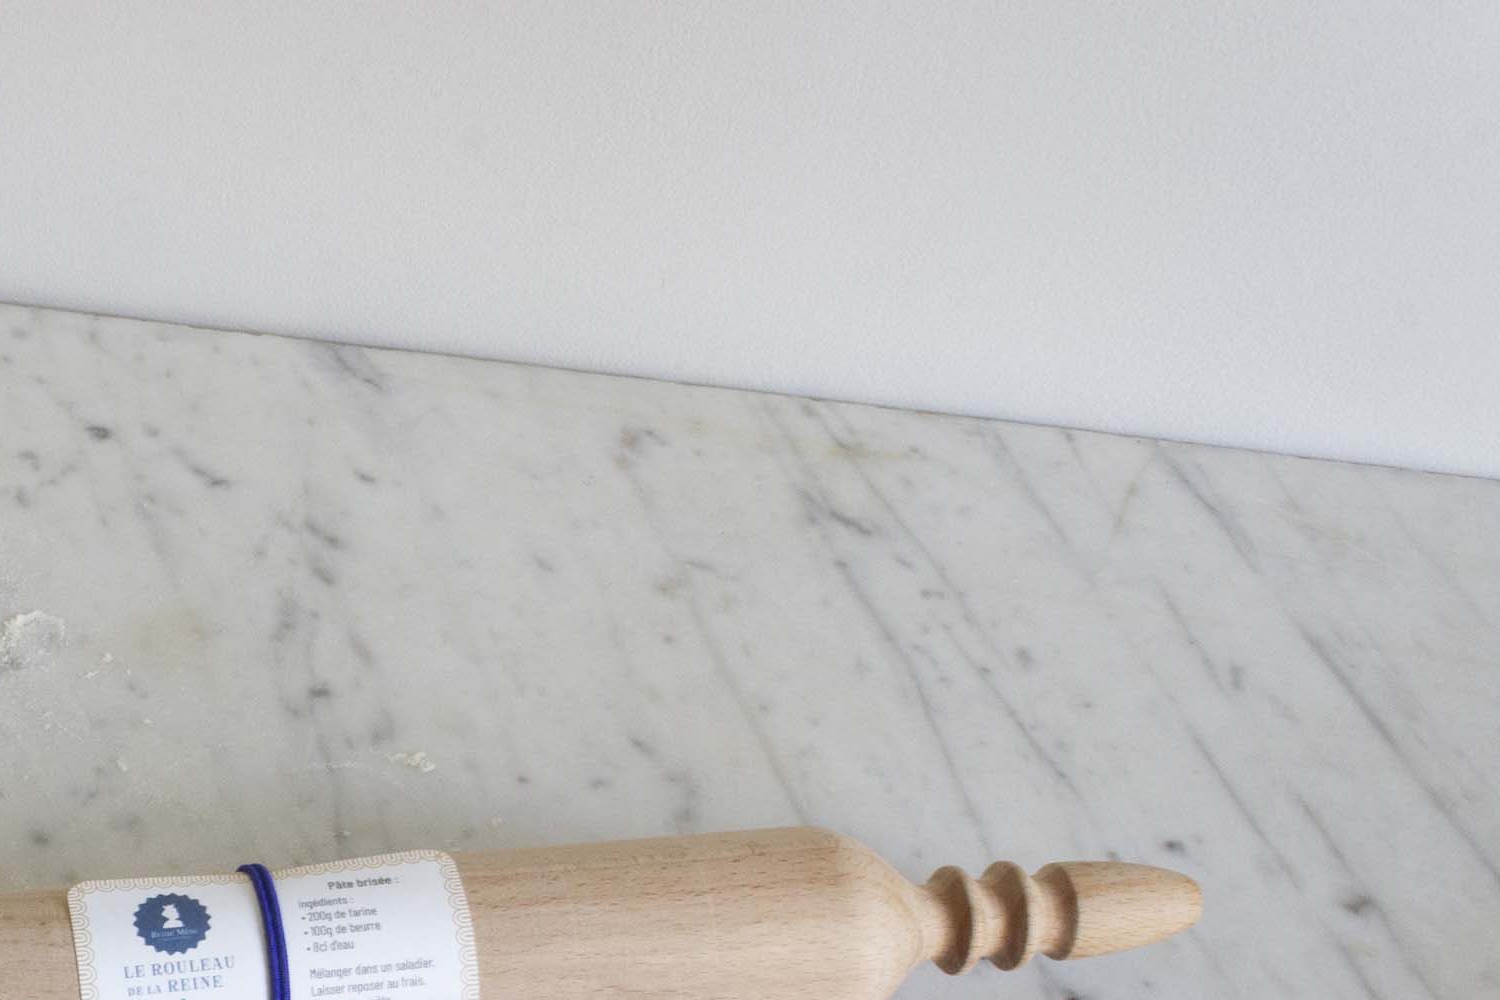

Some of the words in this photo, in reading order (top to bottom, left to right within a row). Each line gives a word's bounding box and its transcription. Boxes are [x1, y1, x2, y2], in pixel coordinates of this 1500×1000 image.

[308, 911, 333, 922] 200g
[334, 910, 347, 920] de
[348, 908, 378, 918] farine
[310, 925, 333, 938] 100g
[335, 925, 348, 934] de
[349, 922, 381, 933] beurre
[124, 965, 145, 979] LE
[152, 955, 235, 976] ROULEAU
[355, 963, 379, 976] dans
[380, 963, 393, 974] un
[127, 987, 144, 997] DE
[147, 985, 162, 995] LA
[168, 975, 224, 992] REINE
[311, 984, 345, 998] Laisser
[347, 980, 384, 995] reposer
[387, 979, 399, 989] au
